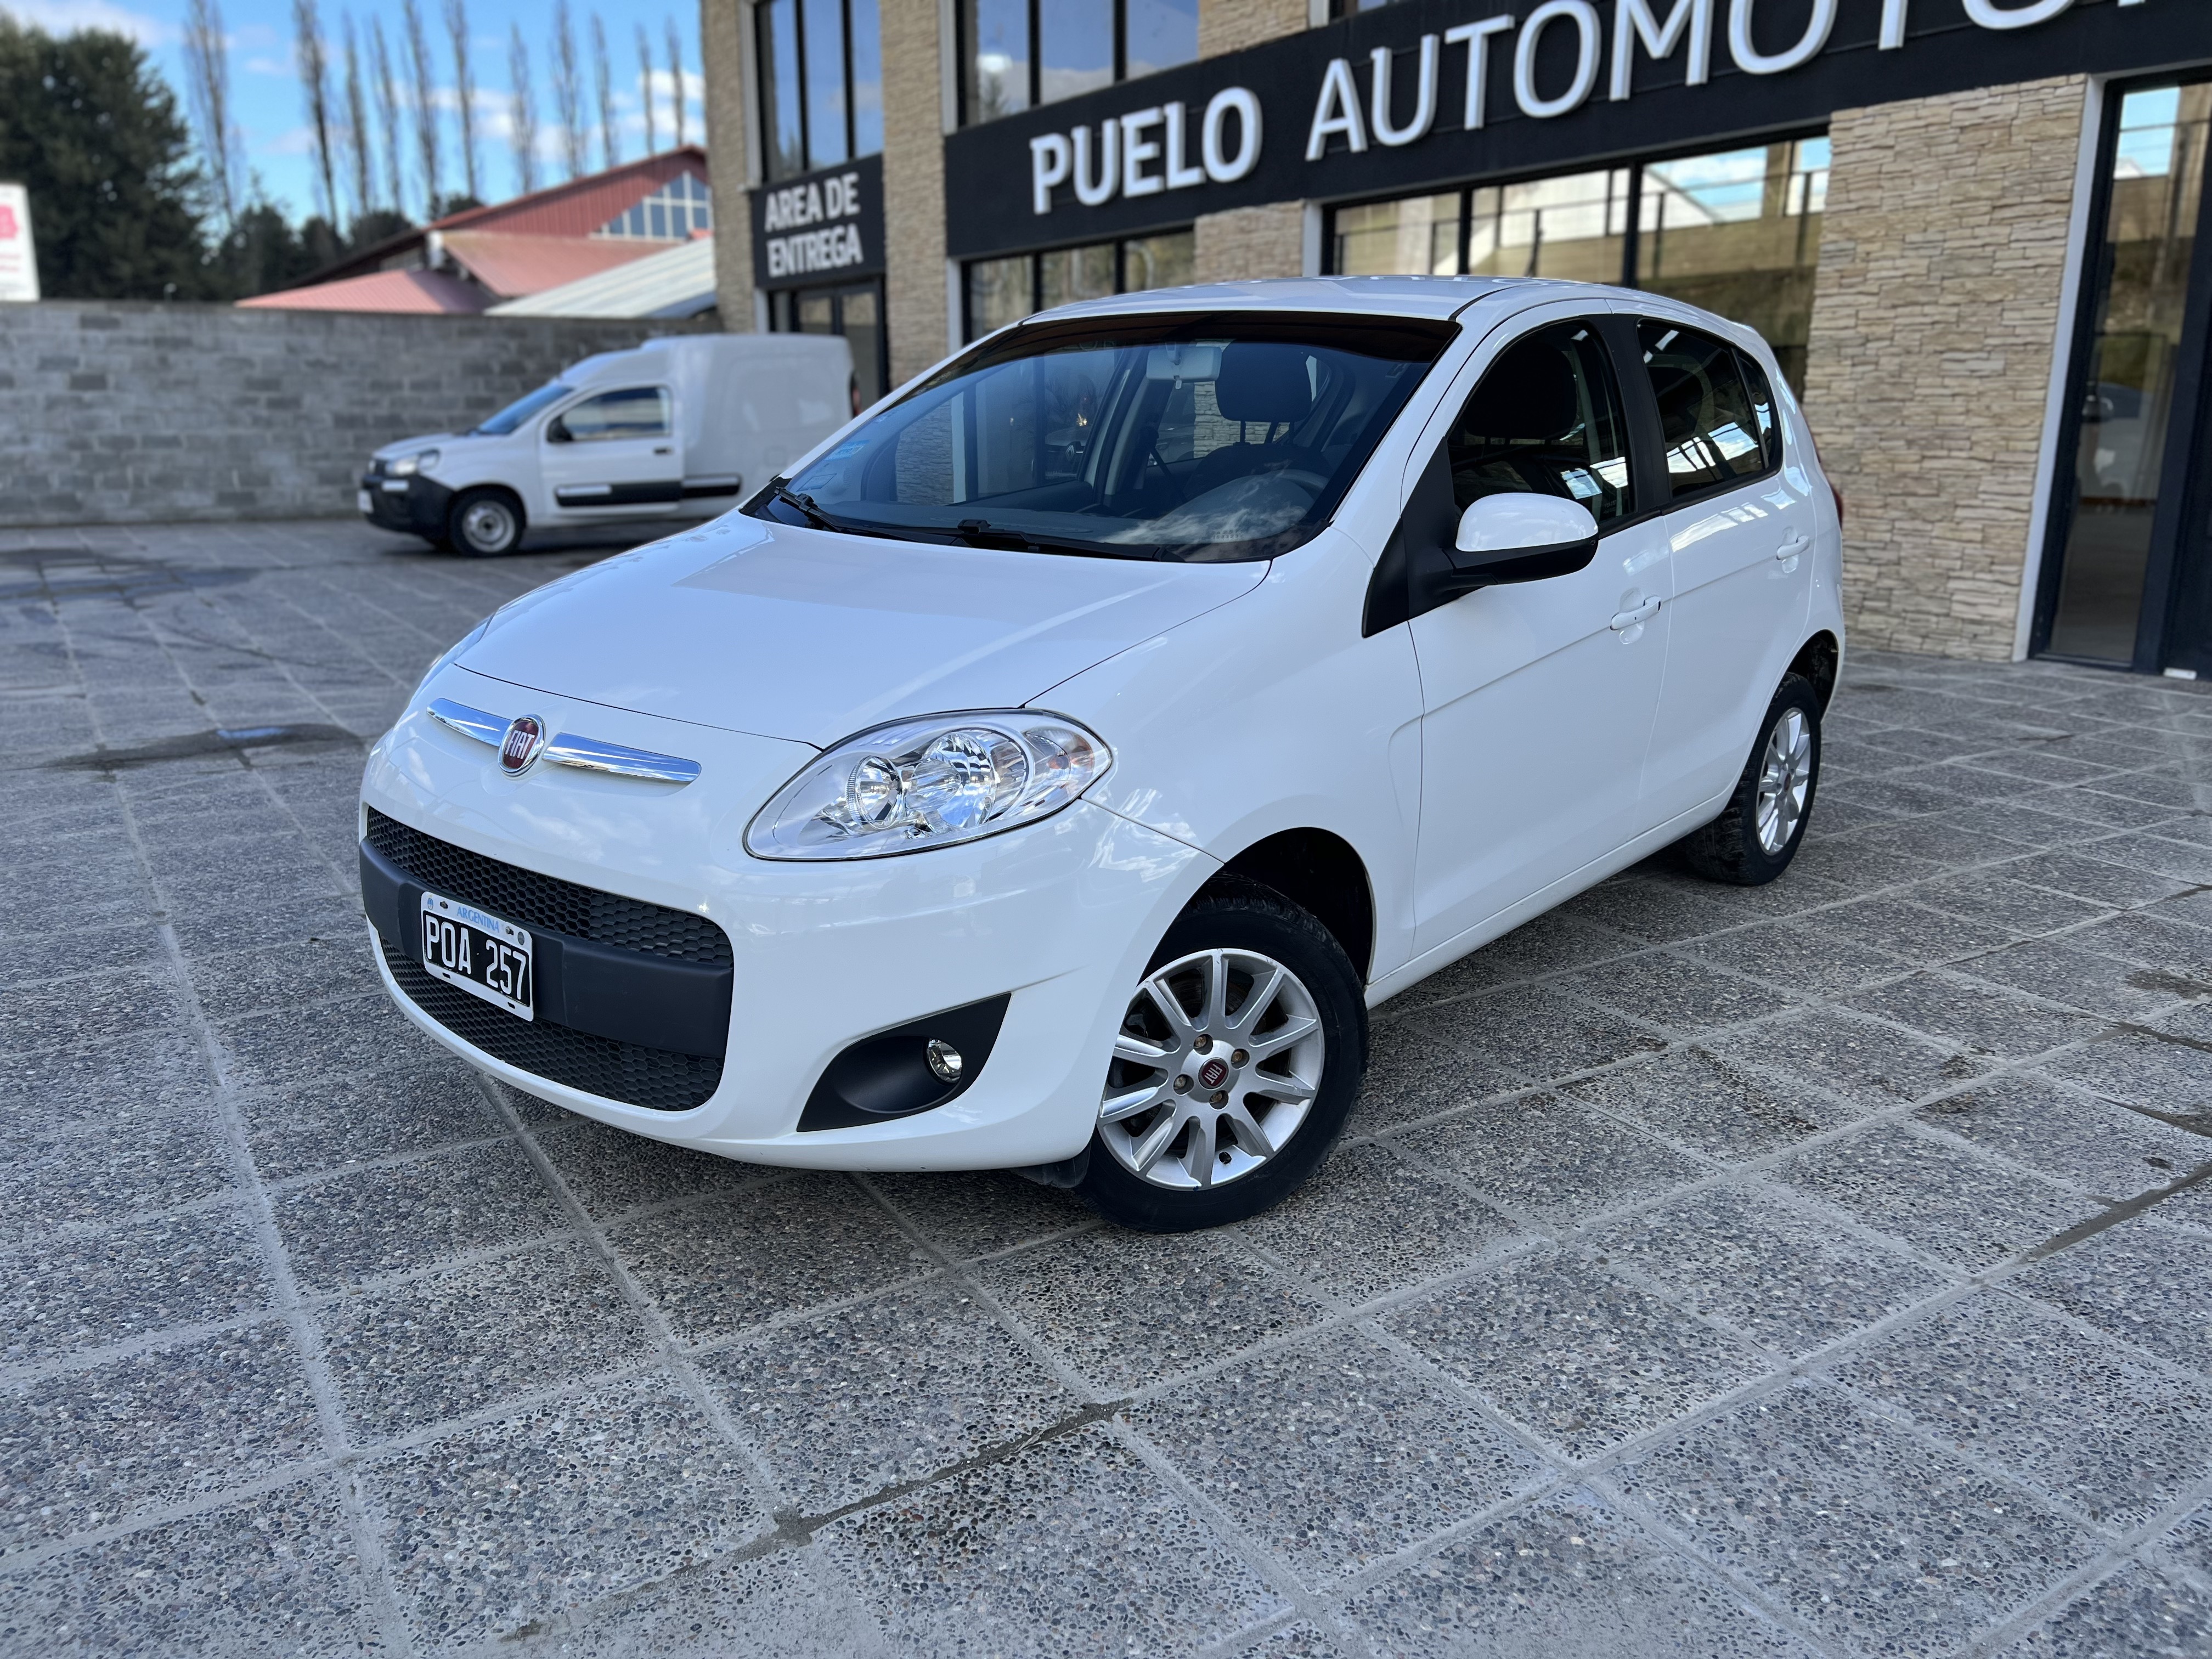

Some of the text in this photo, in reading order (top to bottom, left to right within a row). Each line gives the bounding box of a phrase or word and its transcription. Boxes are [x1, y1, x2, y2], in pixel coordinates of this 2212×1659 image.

[1030, 0, 2144, 215] PUELO AUTOMO
[765, 172, 861, 232] AREA DE
[766, 223, 864, 277] ENTREGA
[505, 730, 535, 759] FIAT
[456, 906, 500, 933] ARGENTINA
[426, 915, 527, 1000] POA 257
[1204, 1063, 1223, 1084] FIAT
